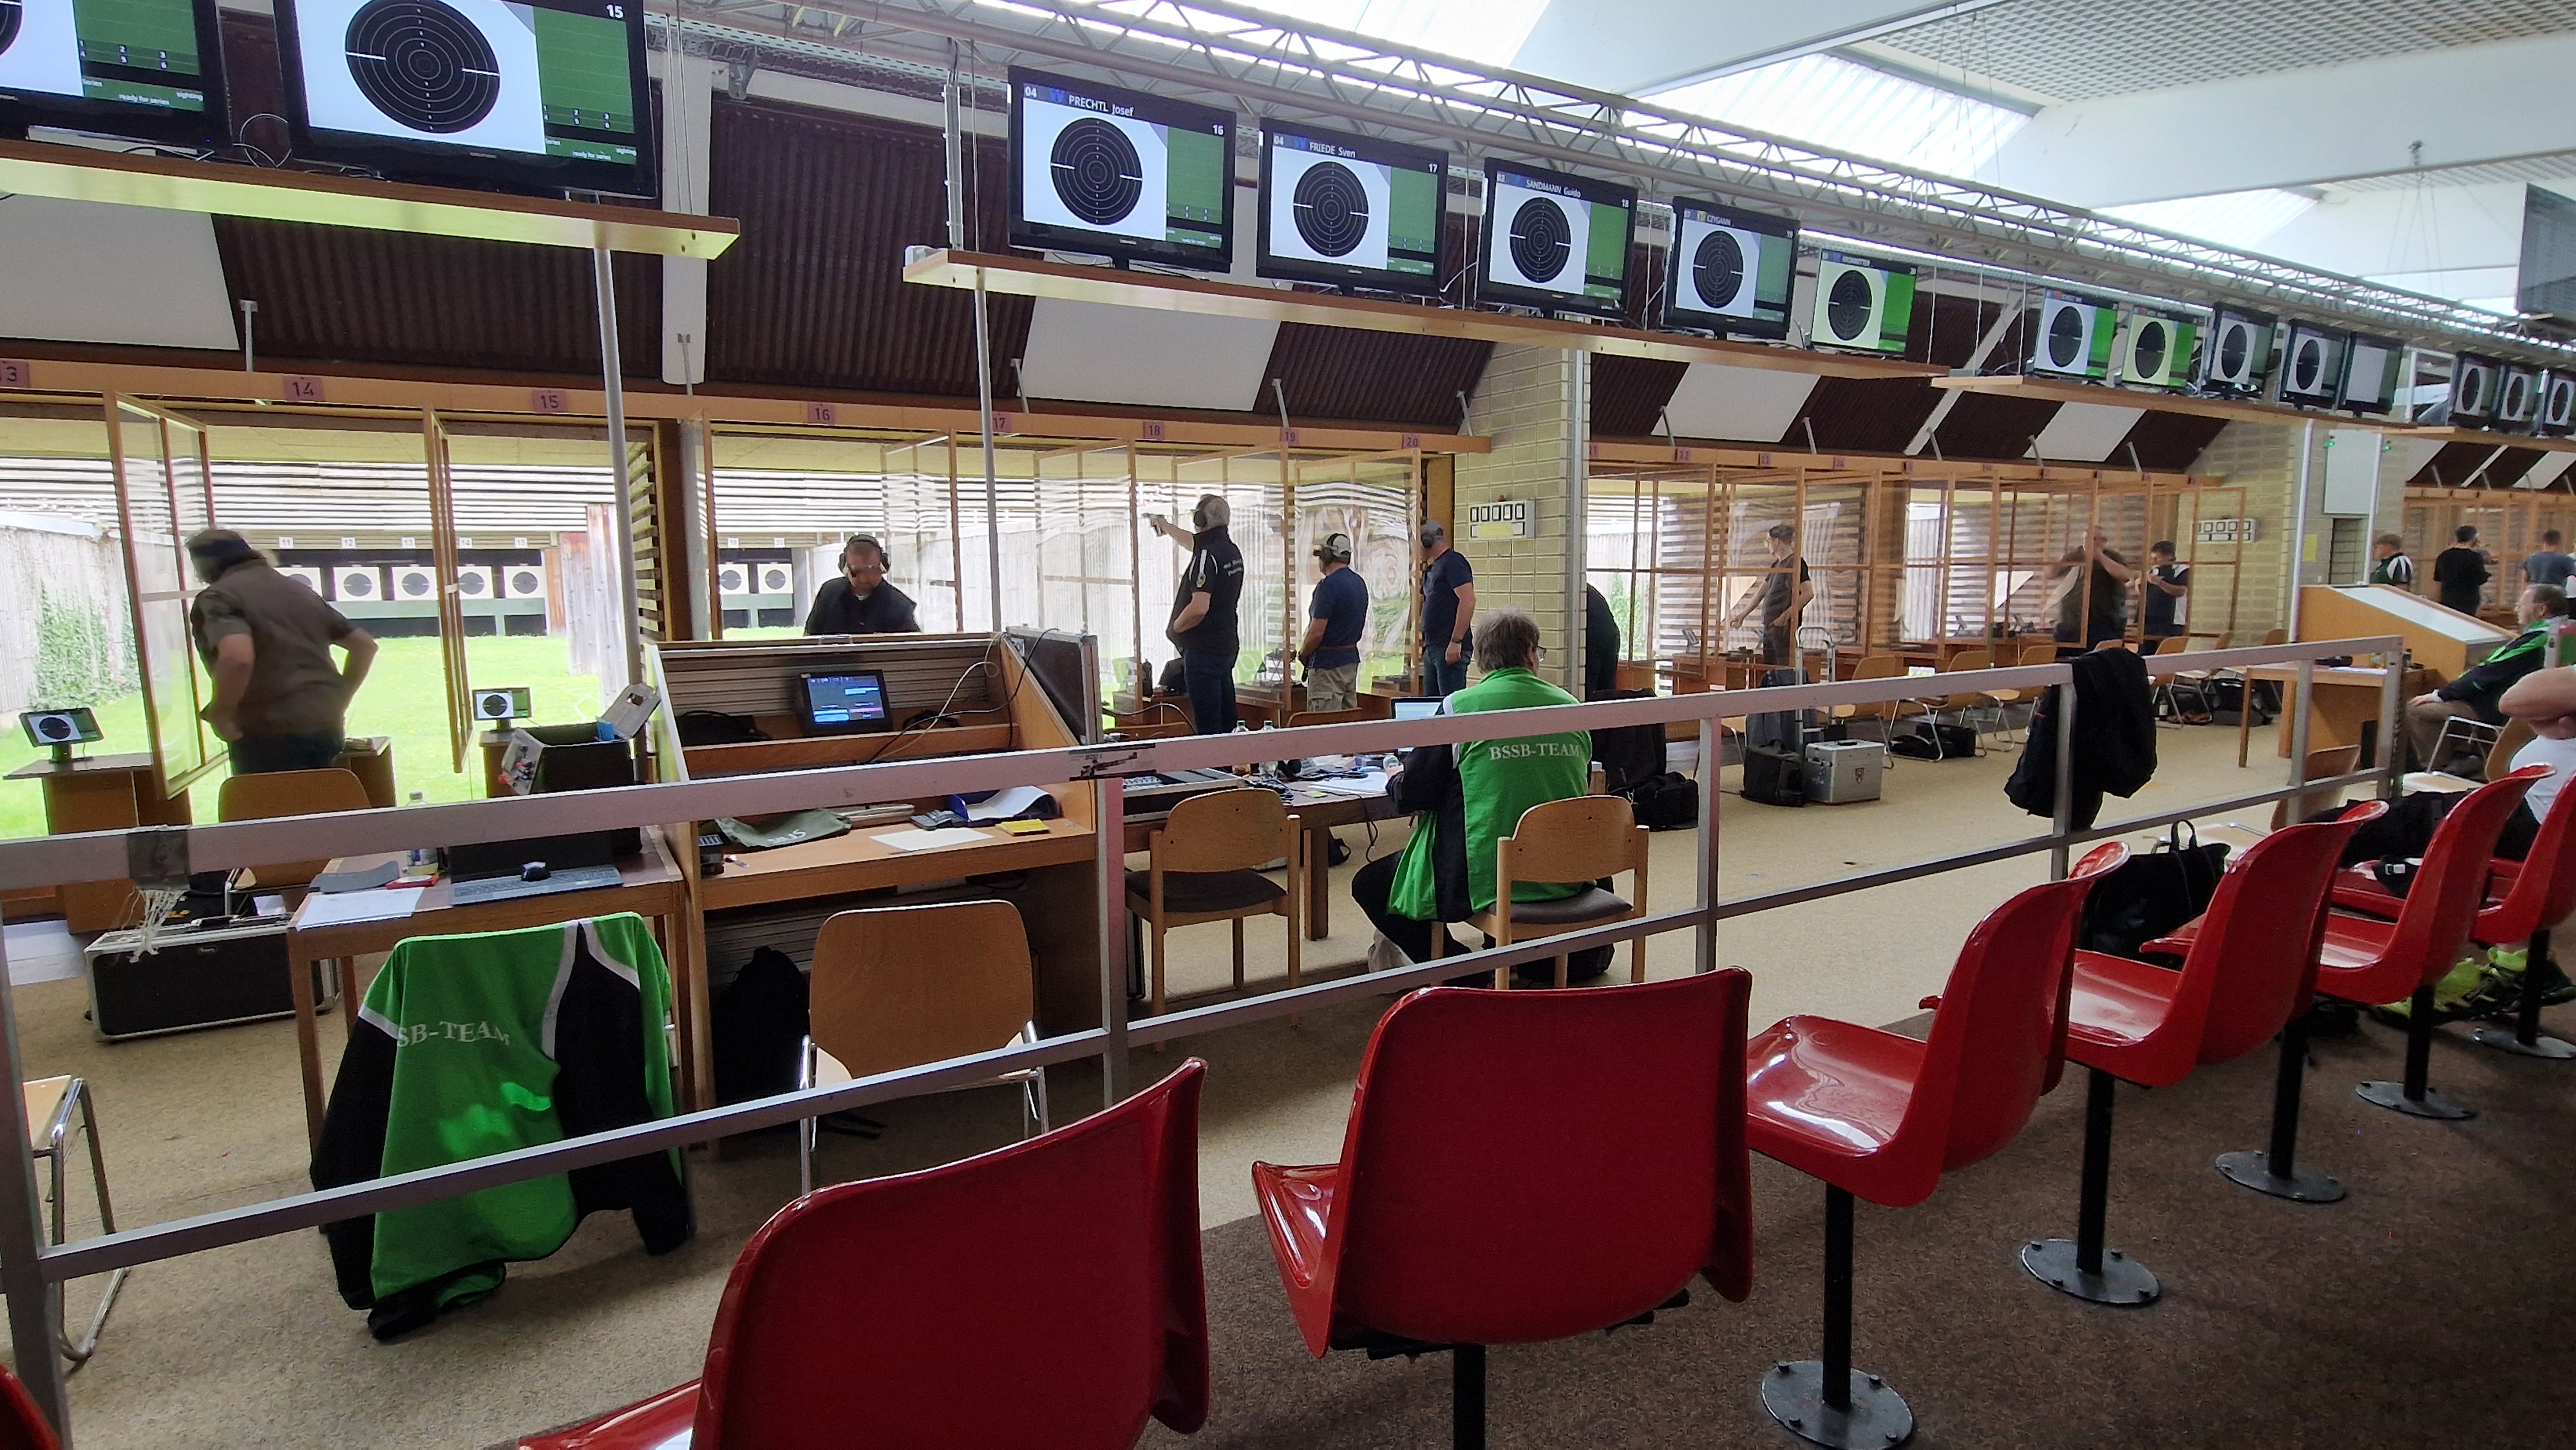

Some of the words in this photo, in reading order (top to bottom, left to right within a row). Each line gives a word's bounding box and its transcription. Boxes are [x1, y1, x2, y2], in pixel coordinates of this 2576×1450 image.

[606, 5, 623, 19] 15
[118, 94, 138, 102] ready
[1025, 86, 1037, 98] 04
[1068, 95, 1109, 111] PRECHTL
[1112, 103, 1134, 117] Josef
[1213, 124, 1224, 135] 16
[1274, 136, 1284, 146] 04
[1309, 142, 1336, 155] FRIEDE
[1338, 147, 1356, 158] Sven
[1428, 164, 1438, 173] 17
[1526, 179, 1562, 194] SANDMANN
[0, 366, 17, 382] 3
[292, 381, 314, 397] 14
[540, 395, 559, 408] 15
[815, 408, 830, 420] 16
[993, 417, 1006, 429] 17
[1149, 426, 1160, 436] 18
[1285, 431, 1296, 442] 19
[1406, 437, 1418, 447] 20
[1490, 743, 1580, 760] BSSB-TEAM
